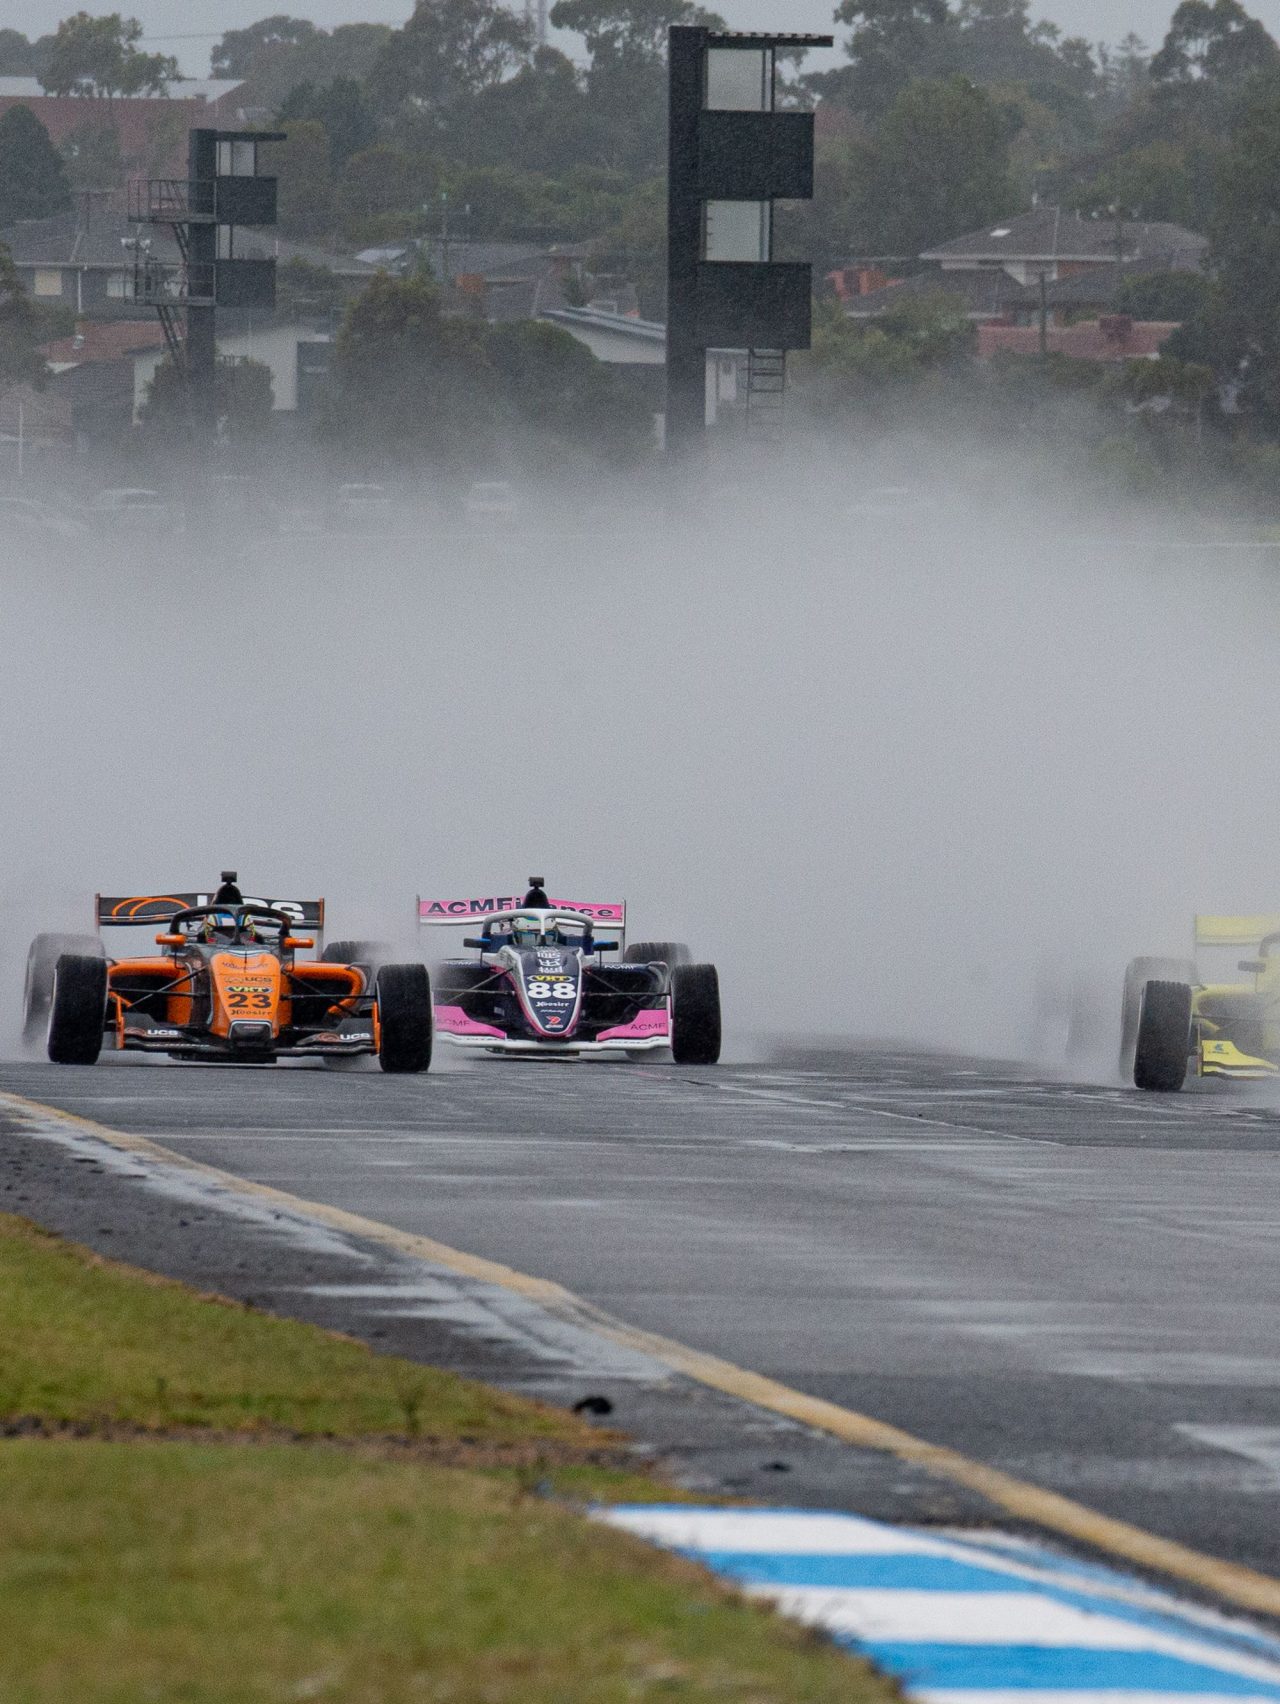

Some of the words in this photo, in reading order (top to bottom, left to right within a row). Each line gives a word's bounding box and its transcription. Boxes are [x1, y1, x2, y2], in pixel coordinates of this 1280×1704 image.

[428, 897, 614, 917] ACMFince
[527, 982, 577, 999] 88
[228, 993, 272, 1009] 23
[630, 1022, 666, 1031] ACMF
[340, 1032, 371, 1041] UCS
